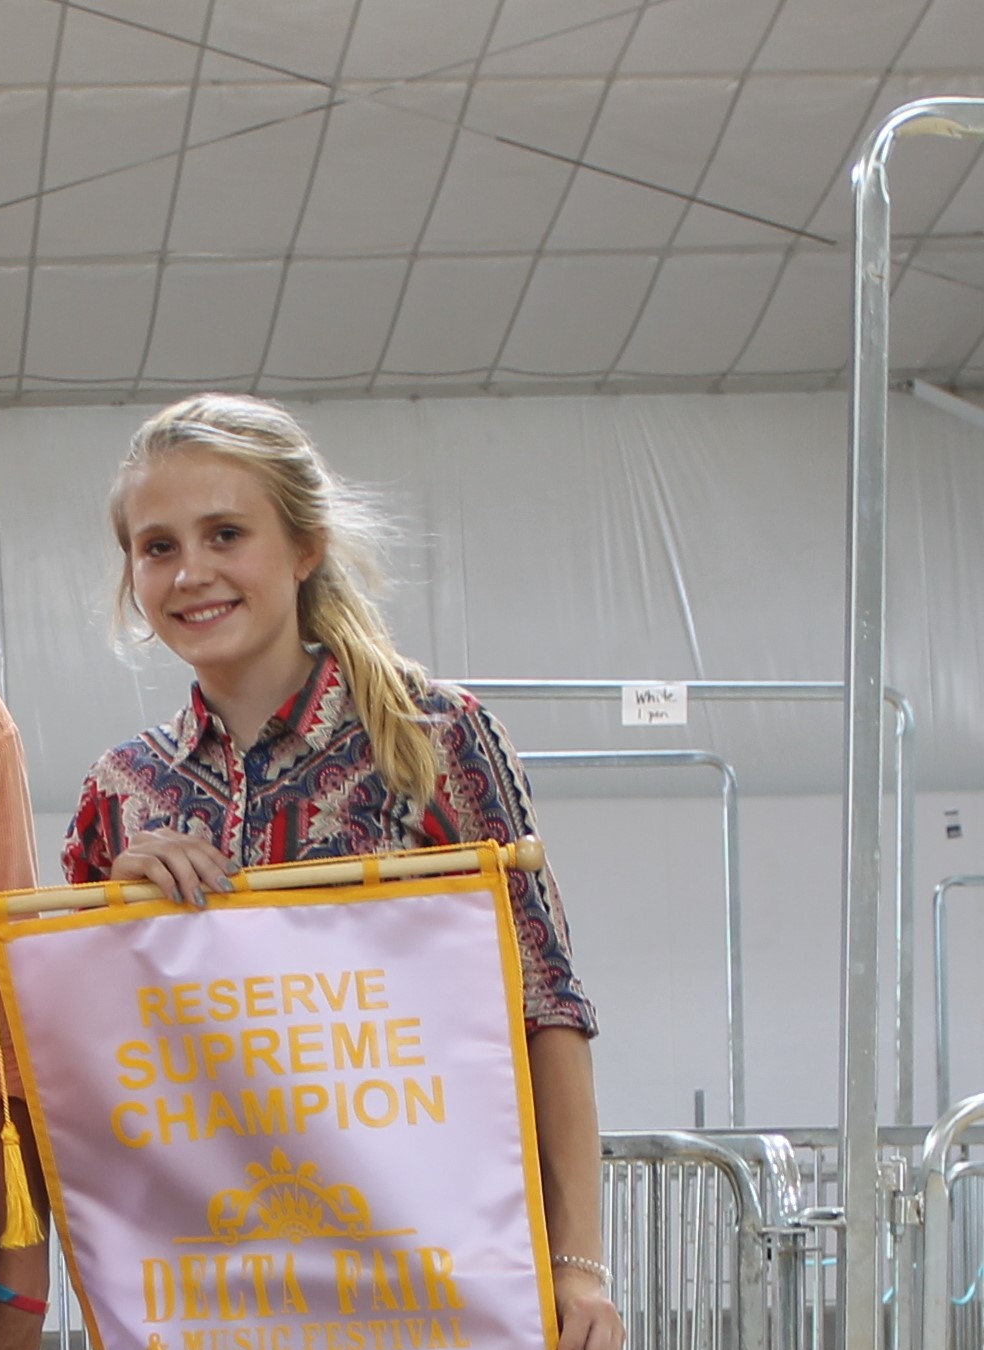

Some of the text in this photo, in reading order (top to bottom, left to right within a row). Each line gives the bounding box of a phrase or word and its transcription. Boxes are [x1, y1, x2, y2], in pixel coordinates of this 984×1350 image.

[136, 968, 389, 1028] RESERVE
[116, 1017, 426, 1090] SUPREME
[110, 1075, 446, 1150] CHAMPION
[141, 1246, 465, 1323] DELTA FAIR
